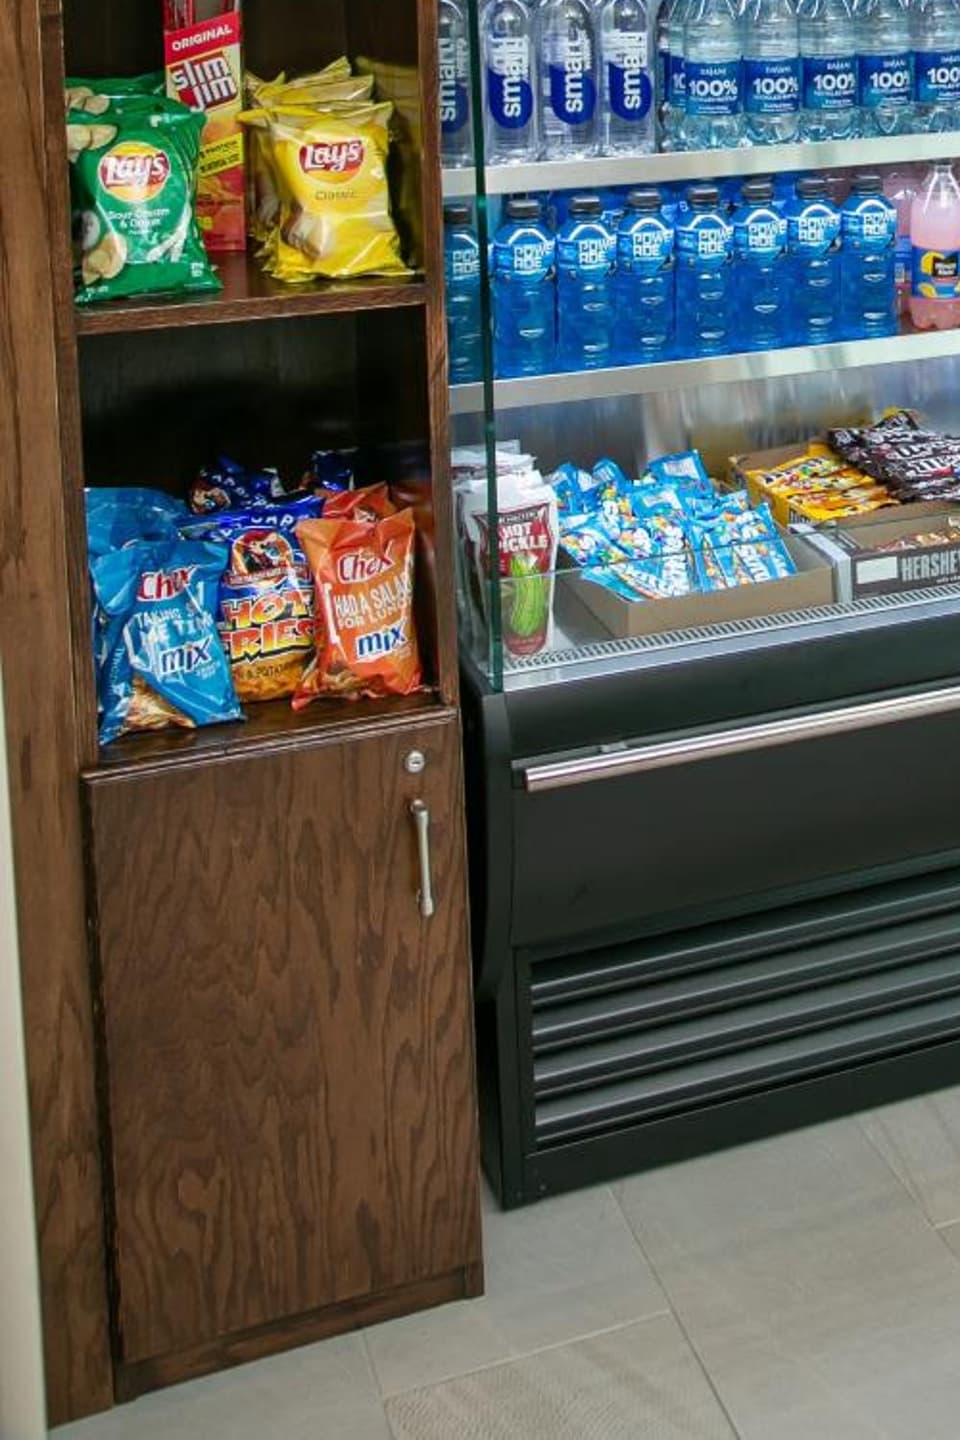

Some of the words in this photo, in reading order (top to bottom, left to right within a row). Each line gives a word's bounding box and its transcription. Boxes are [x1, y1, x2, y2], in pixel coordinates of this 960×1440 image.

[171, 24, 234, 52] ORIGINAL
[689, 78, 738, 97] 100%
[753, 77, 799, 95] 100%
[303, 140, 362, 172] Lay's
[339, 552, 392, 582] Chex
[223, 589, 314, 629] HOT
[161, 637, 211, 673] mix
[357, 625, 406, 657] mix
